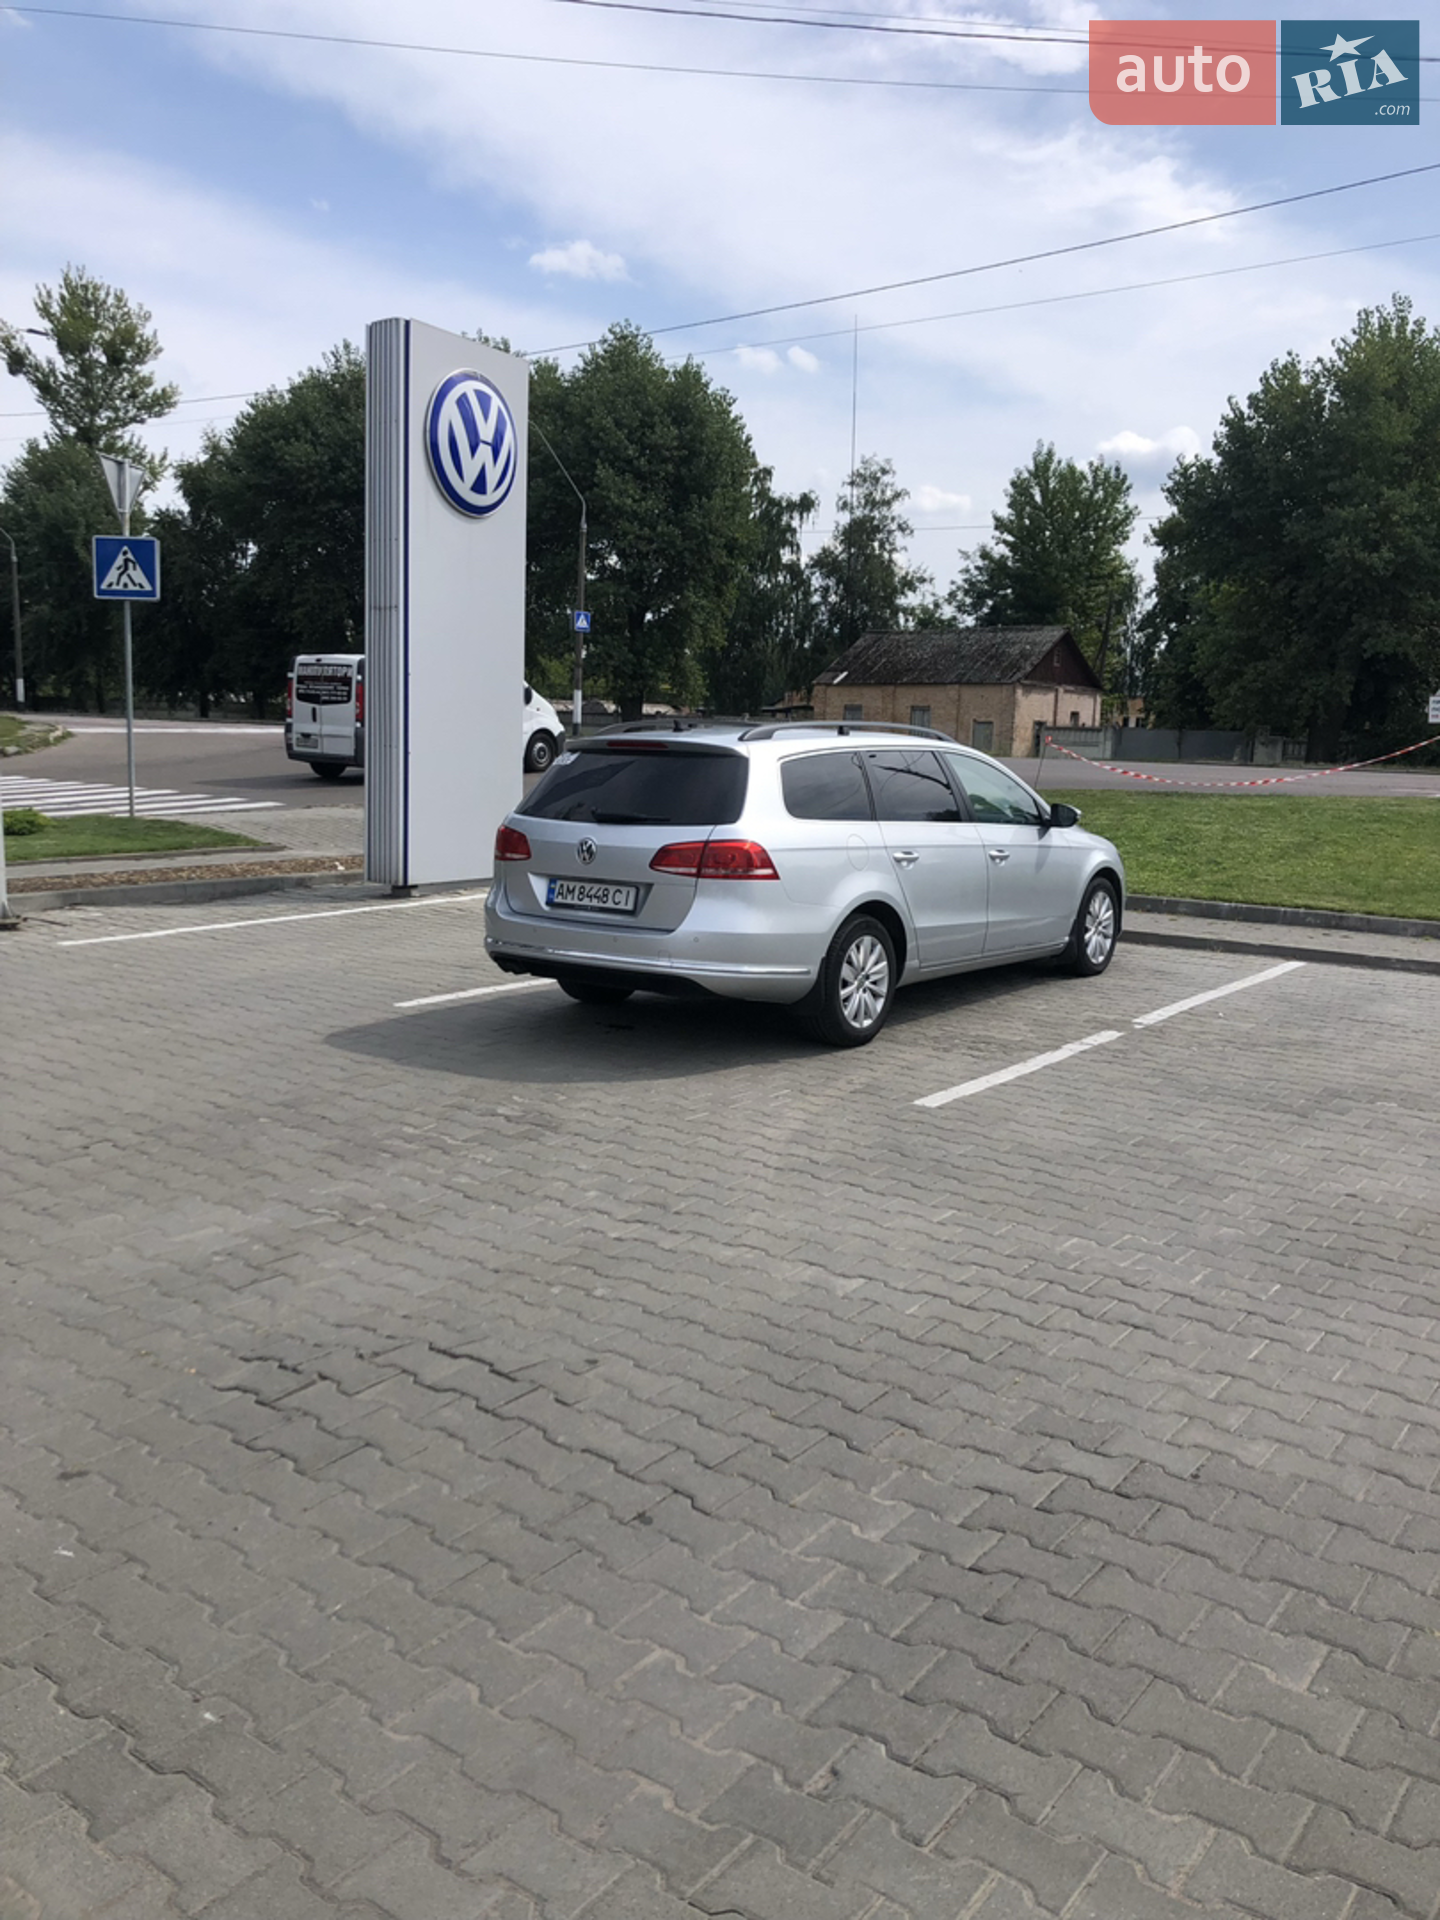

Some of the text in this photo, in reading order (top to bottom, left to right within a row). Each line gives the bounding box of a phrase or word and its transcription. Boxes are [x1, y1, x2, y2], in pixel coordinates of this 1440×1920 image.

[556, 883, 631, 907] AM 8448 CI
